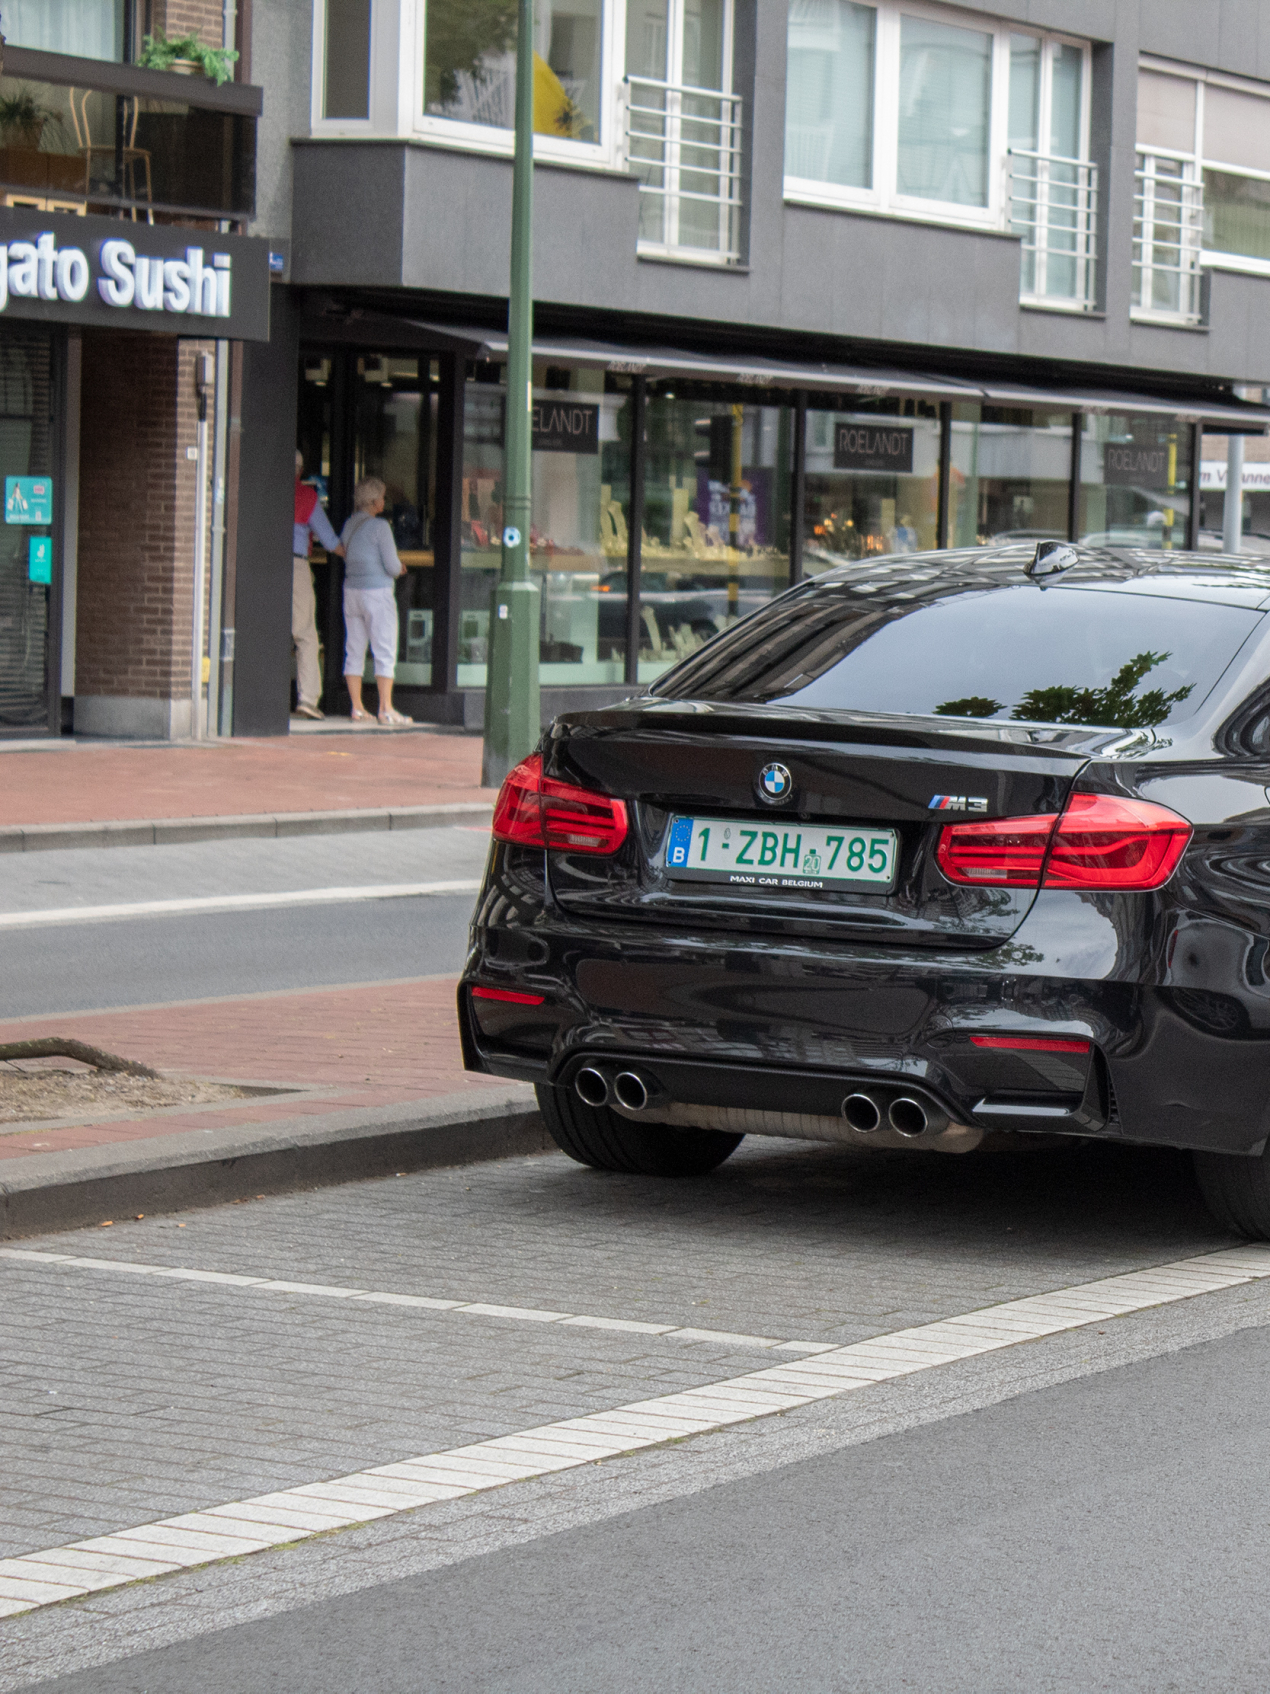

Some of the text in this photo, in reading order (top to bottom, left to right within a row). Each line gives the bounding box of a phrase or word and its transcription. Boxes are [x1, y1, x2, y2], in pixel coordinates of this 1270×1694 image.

[0, 231, 232, 318] ato Sushi
[532, 406, 592, 435] ELANDT
[840, 429, 908, 455] ROELANDT
[943, 794, 989, 812] M3
[672, 827, 890, 874] B 1-ZBH-785
[730, 875, 824, 888] MAXI CAR BELGIUM
